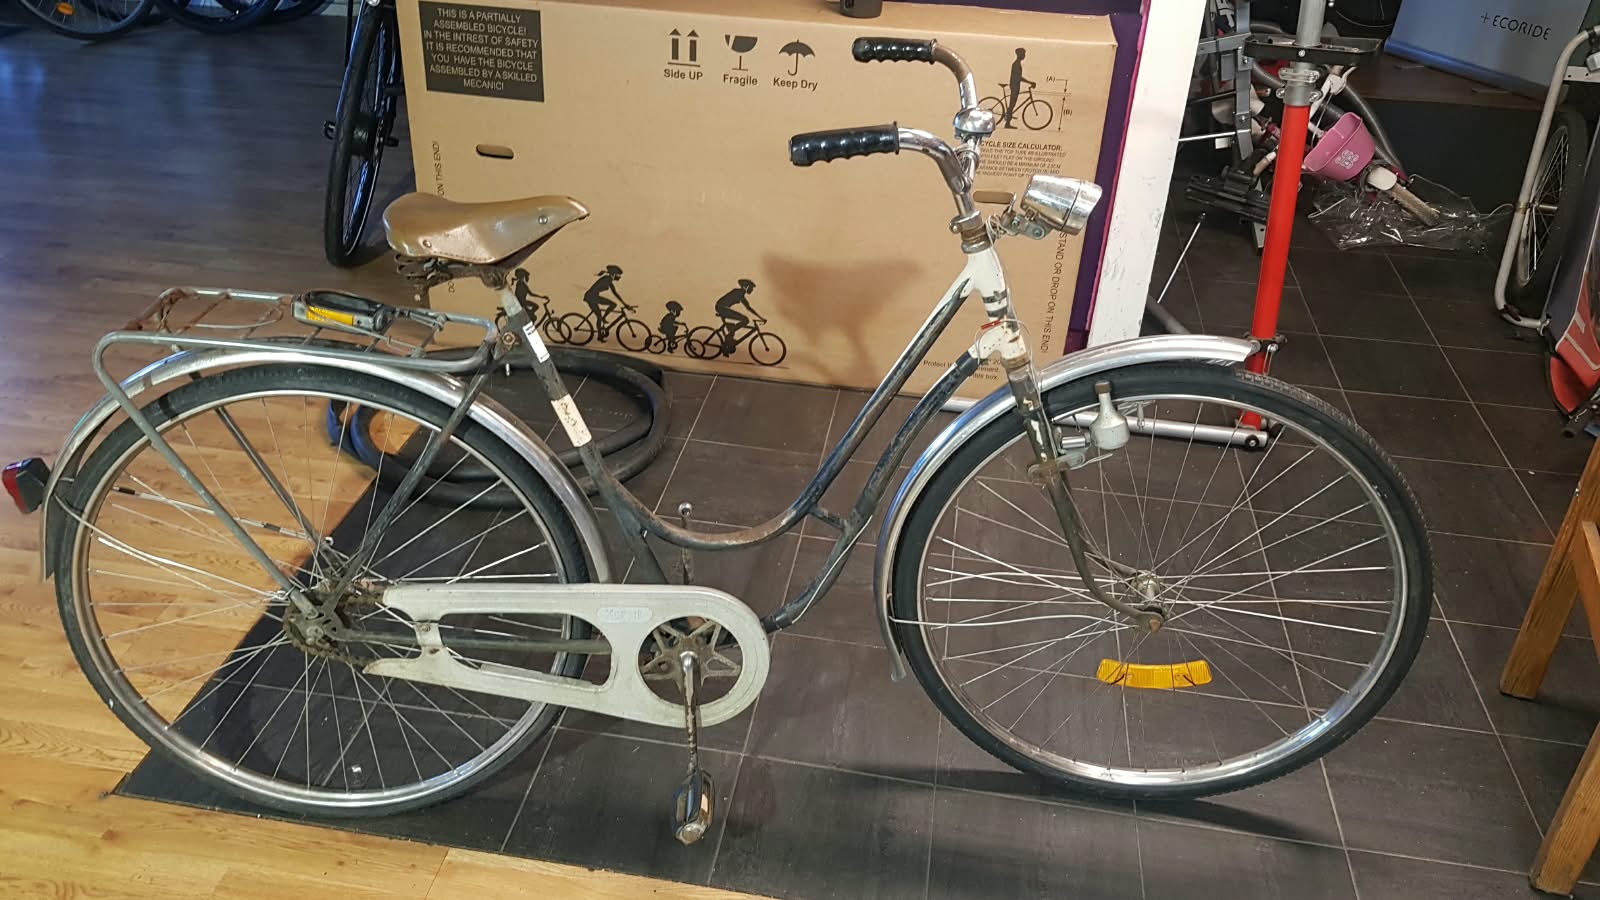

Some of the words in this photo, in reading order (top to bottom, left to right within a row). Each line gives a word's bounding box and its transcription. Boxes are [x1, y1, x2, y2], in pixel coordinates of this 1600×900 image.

[437, 8, 457, 18] THIS
[459, 9, 467, 19] IS
[469, 10, 475, 19] A
[476, 11, 521, 24] PARTIALLY
[433, 20, 485, 33] ASSEMBLED
[424, 30, 432, 39] IN
[434, 31, 451, 41] THE
[452, 32, 489, 44] INTREST
[491, 36, 502, 45] OF
[505, 38, 539, 48] SAFETY
[426, 41, 433, 50] IT
[436, 42, 444, 51] IS
[446, 43, 514, 57] RECOMMENDED
[516, 50, 537, 60] THAT
[432, 54, 450, 63] YOU
[454, 56, 476, 66] HAVE
[478, 58, 495, 68] THE
[497, 59, 533, 71] BICYCLE
[429, 64, 480, 77] ASSEMBLED
[482, 69, 494, 78] BY
[495, 70, 501, 79] A
[502, 71, 537, 83] SKILLED
[663, 68, 686, 80] Side
[688, 71, 704, 81] UP
[723, 73, 758, 87] Fragile
[773, 77, 798, 90] Keep
[801, 79, 818, 91] Dry
[980, 140, 1001, 148] CYCLE
[1056, 231, 1067, 261] STAND
[1052, 262, 1062, 275] OR
[1050, 276, 1060, 300] DROP
[1046, 301, 1055, 314] ON
[1043, 315, 1053, 333] THIS
